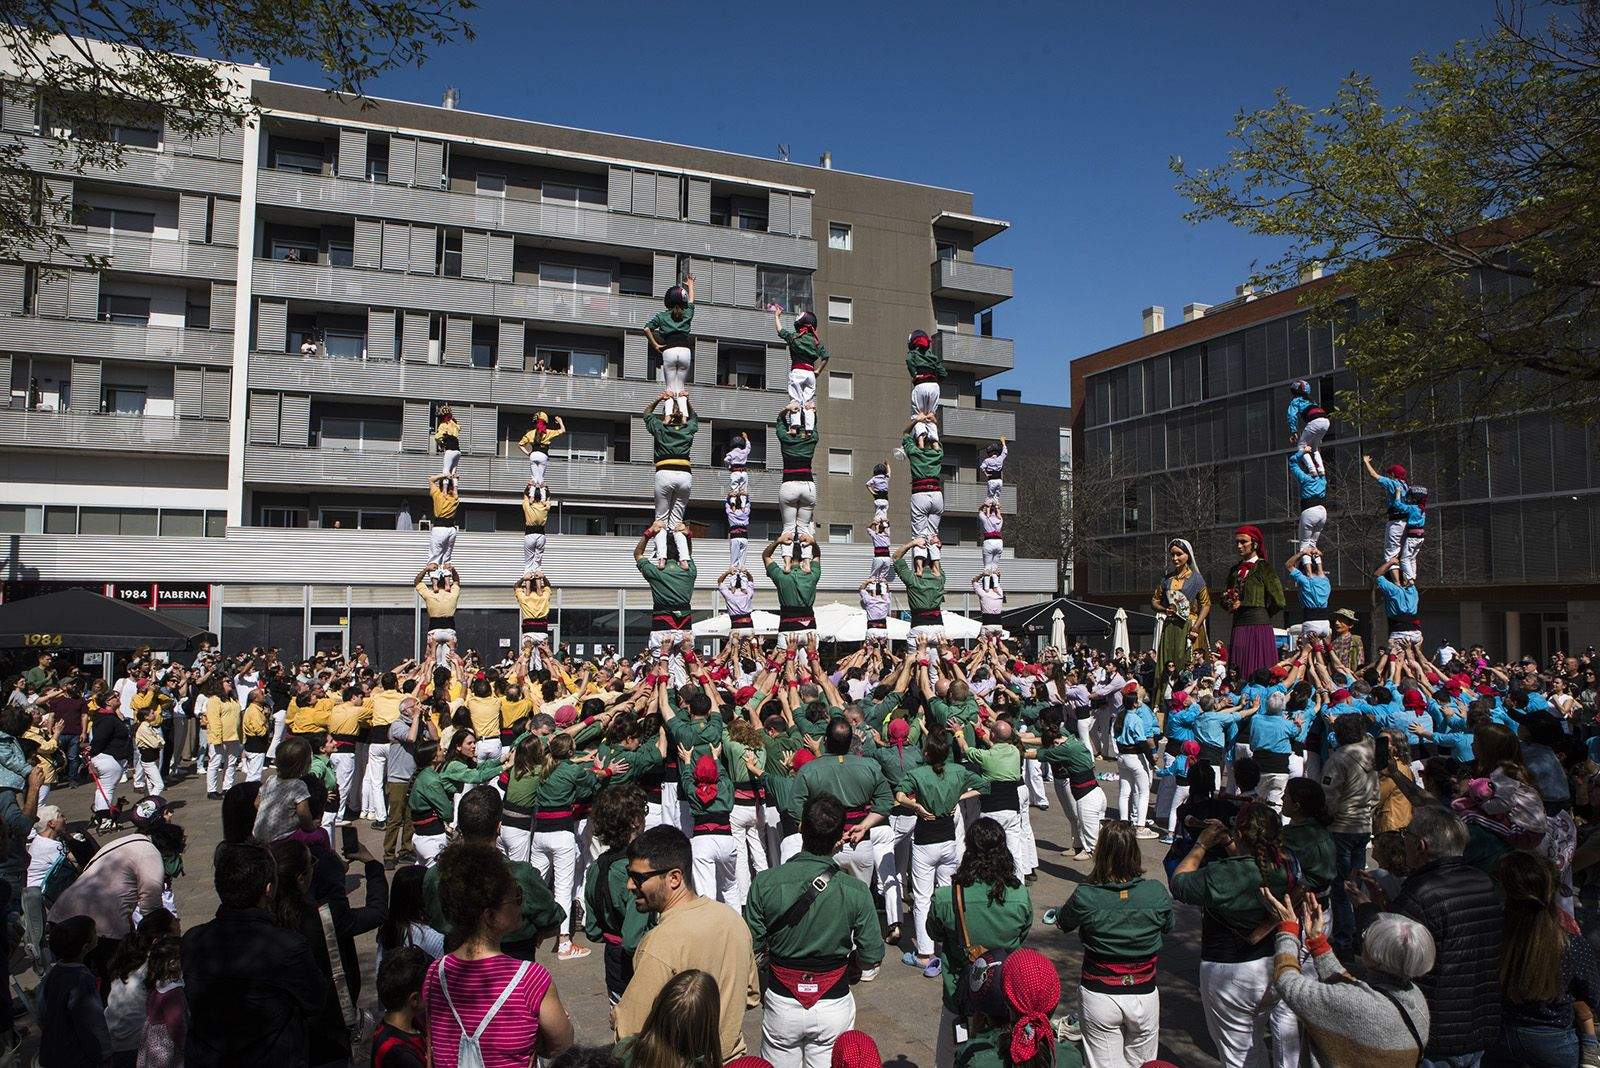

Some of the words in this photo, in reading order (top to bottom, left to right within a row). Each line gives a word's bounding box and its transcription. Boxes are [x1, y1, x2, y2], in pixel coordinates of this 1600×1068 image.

[120, 589, 148, 599] 1984
[158, 589, 207, 599] TABERNA
[23, 633, 63, 646] 1984
